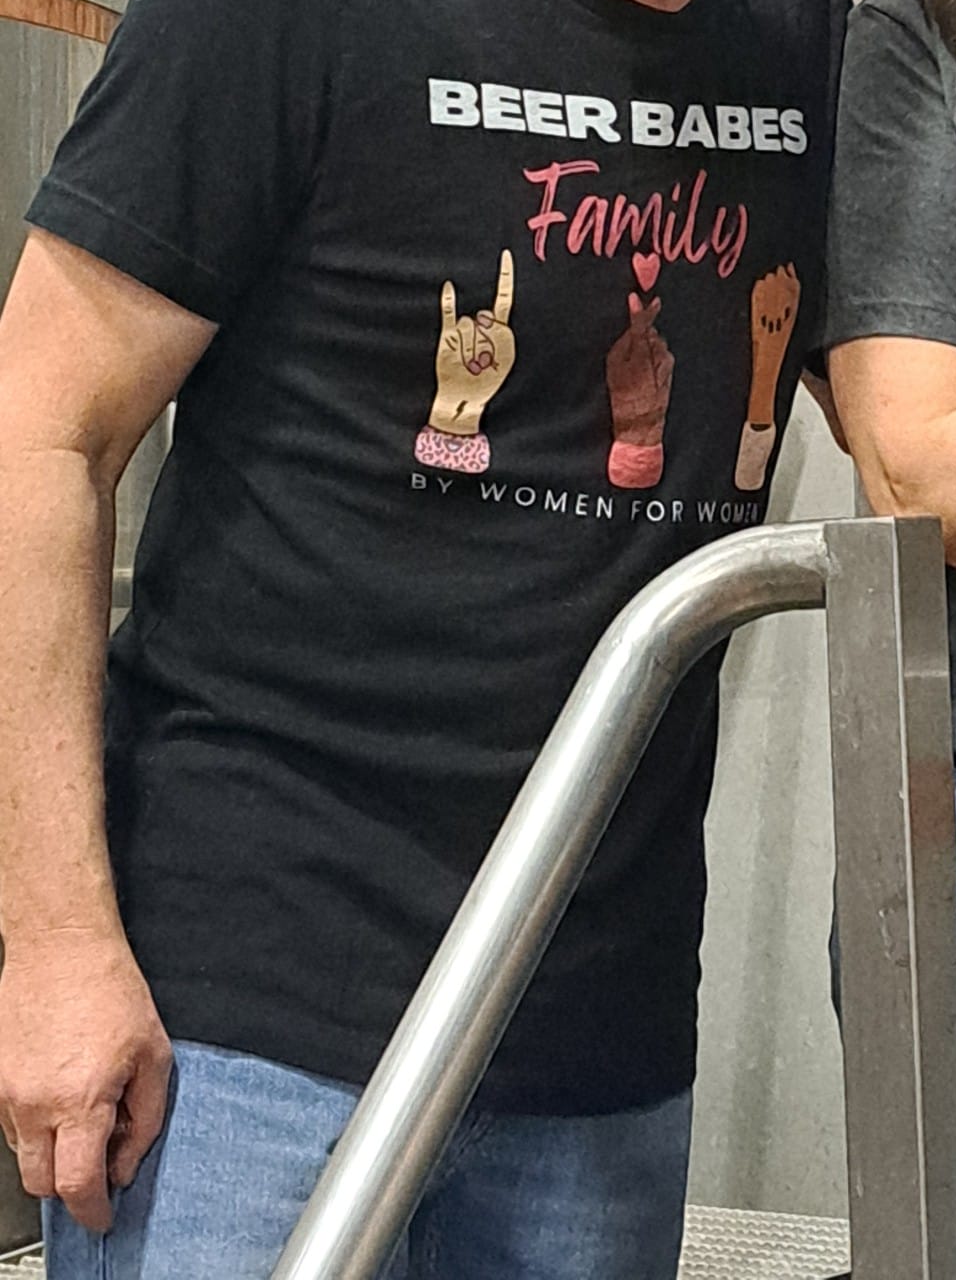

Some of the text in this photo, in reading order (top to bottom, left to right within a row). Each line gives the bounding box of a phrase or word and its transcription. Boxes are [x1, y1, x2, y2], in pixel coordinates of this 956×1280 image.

[428, 78, 808, 154] BEER BABES
[523, 160, 748, 278] Family
[410, 473, 453, 494] BY
[480, 483, 614, 518] WOMEN
[630, 500, 684, 521] FOR
